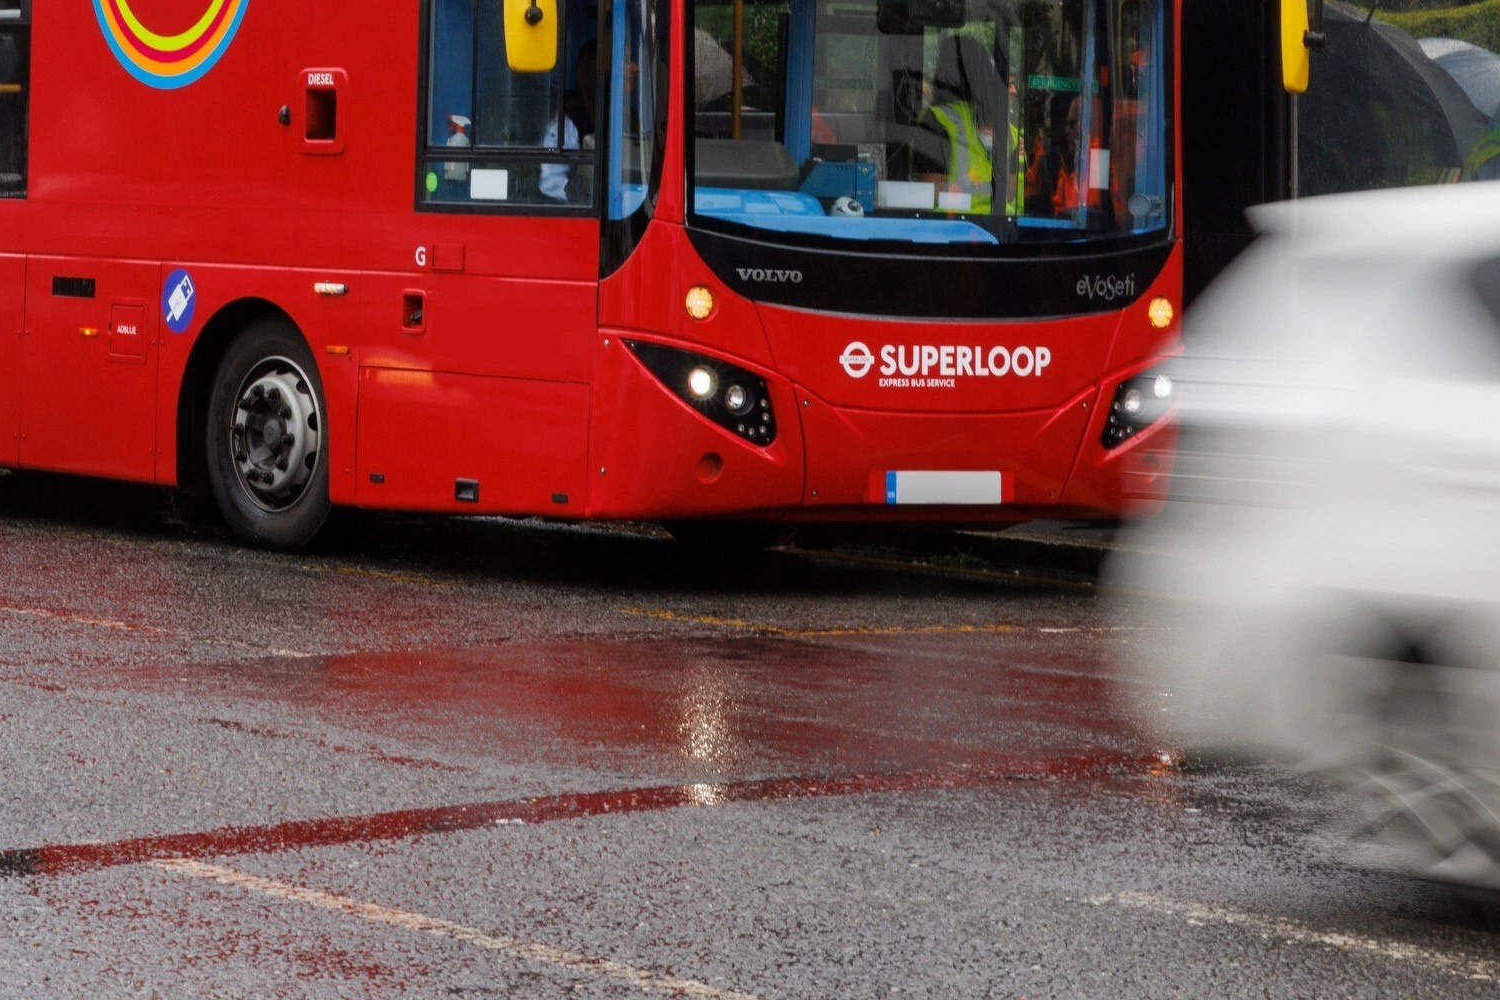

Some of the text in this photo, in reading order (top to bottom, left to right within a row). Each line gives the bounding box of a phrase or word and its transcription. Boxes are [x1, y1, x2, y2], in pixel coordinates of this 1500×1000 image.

[307, 72, 335, 85] DIESEL
[415, 245, 426, 266] G
[735, 267, 804, 284] VOLVO
[879, 344, 1052, 377] SUPERLOOP
[879, 378, 955, 388] EXPRESS BUS SERVICE
